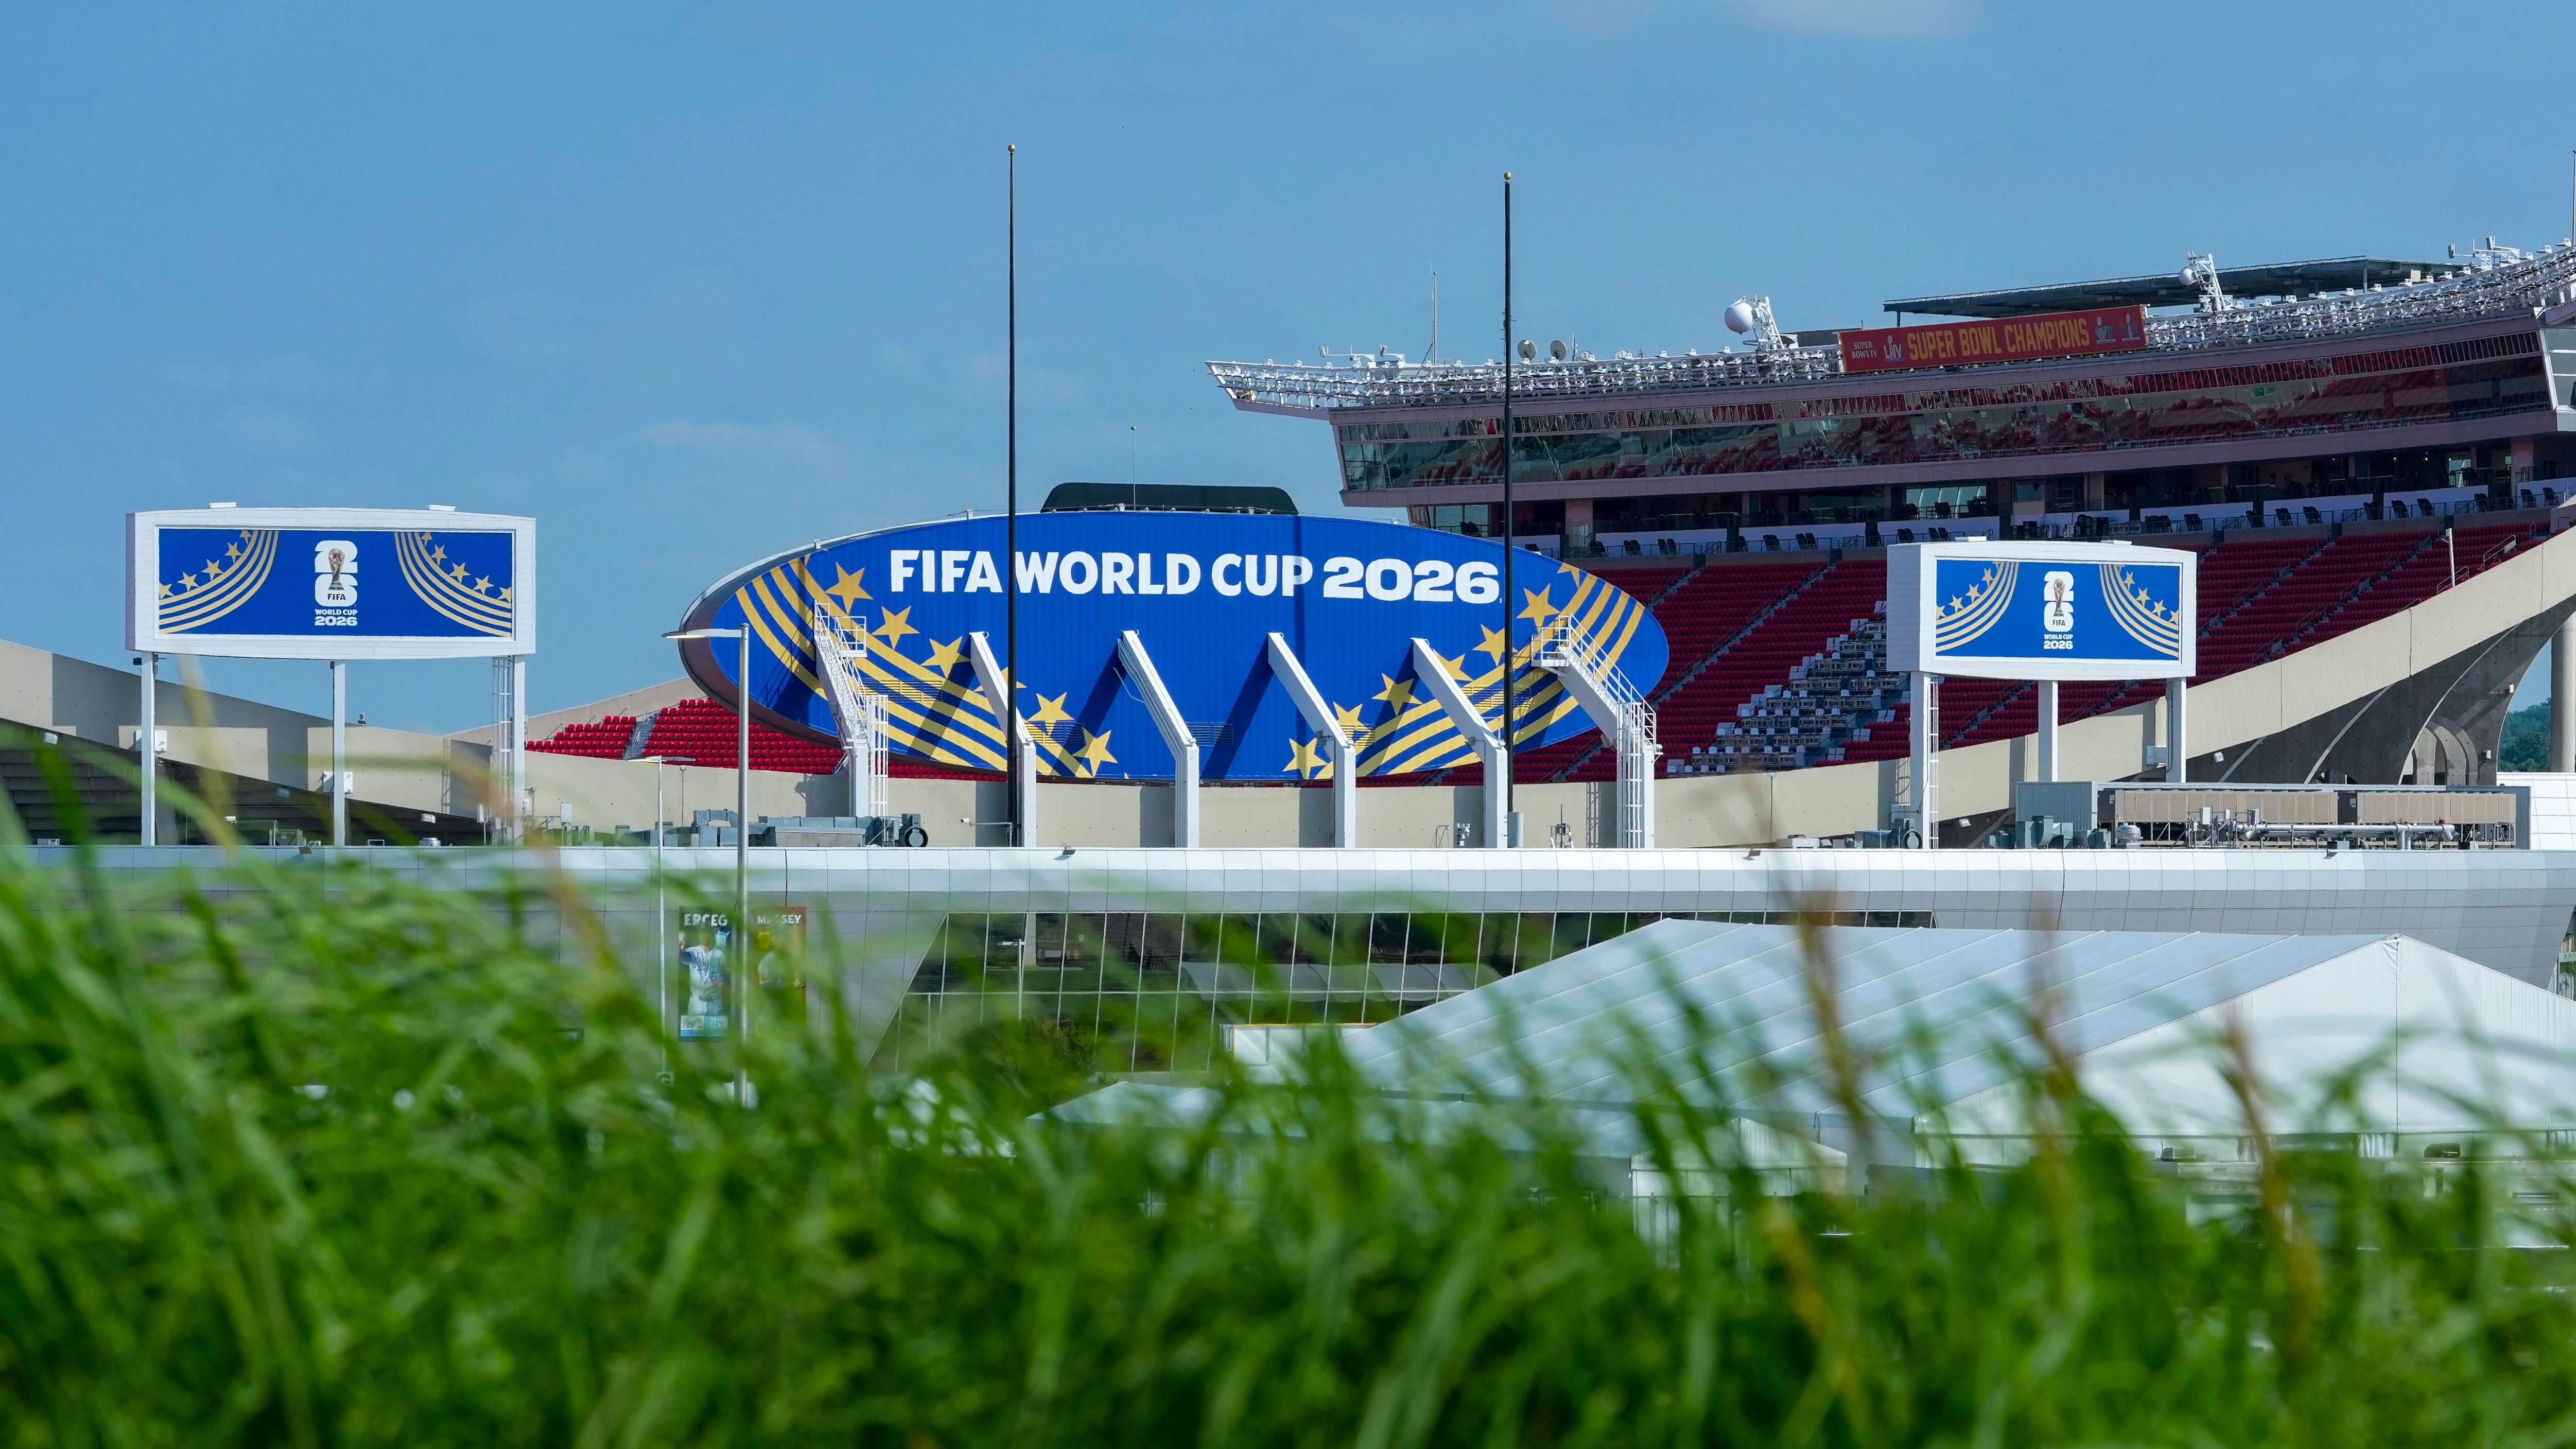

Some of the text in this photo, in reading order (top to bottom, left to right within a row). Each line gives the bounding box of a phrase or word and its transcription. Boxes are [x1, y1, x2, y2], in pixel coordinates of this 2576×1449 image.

[1907, 329, 1956, 360] SUPER
[1959, 326, 2002, 356] BOWL
[2004, 318, 2090, 353] CHAMPIONS
[1853, 341, 1873, 350] SUPER
[1852, 351, 1870, 359] BOWL
[891, 550, 1500, 604] FIFA WORLD CUP 2026
[315, 616, 358, 626] 2026
[2044, 640, 2074, 650] 2026
